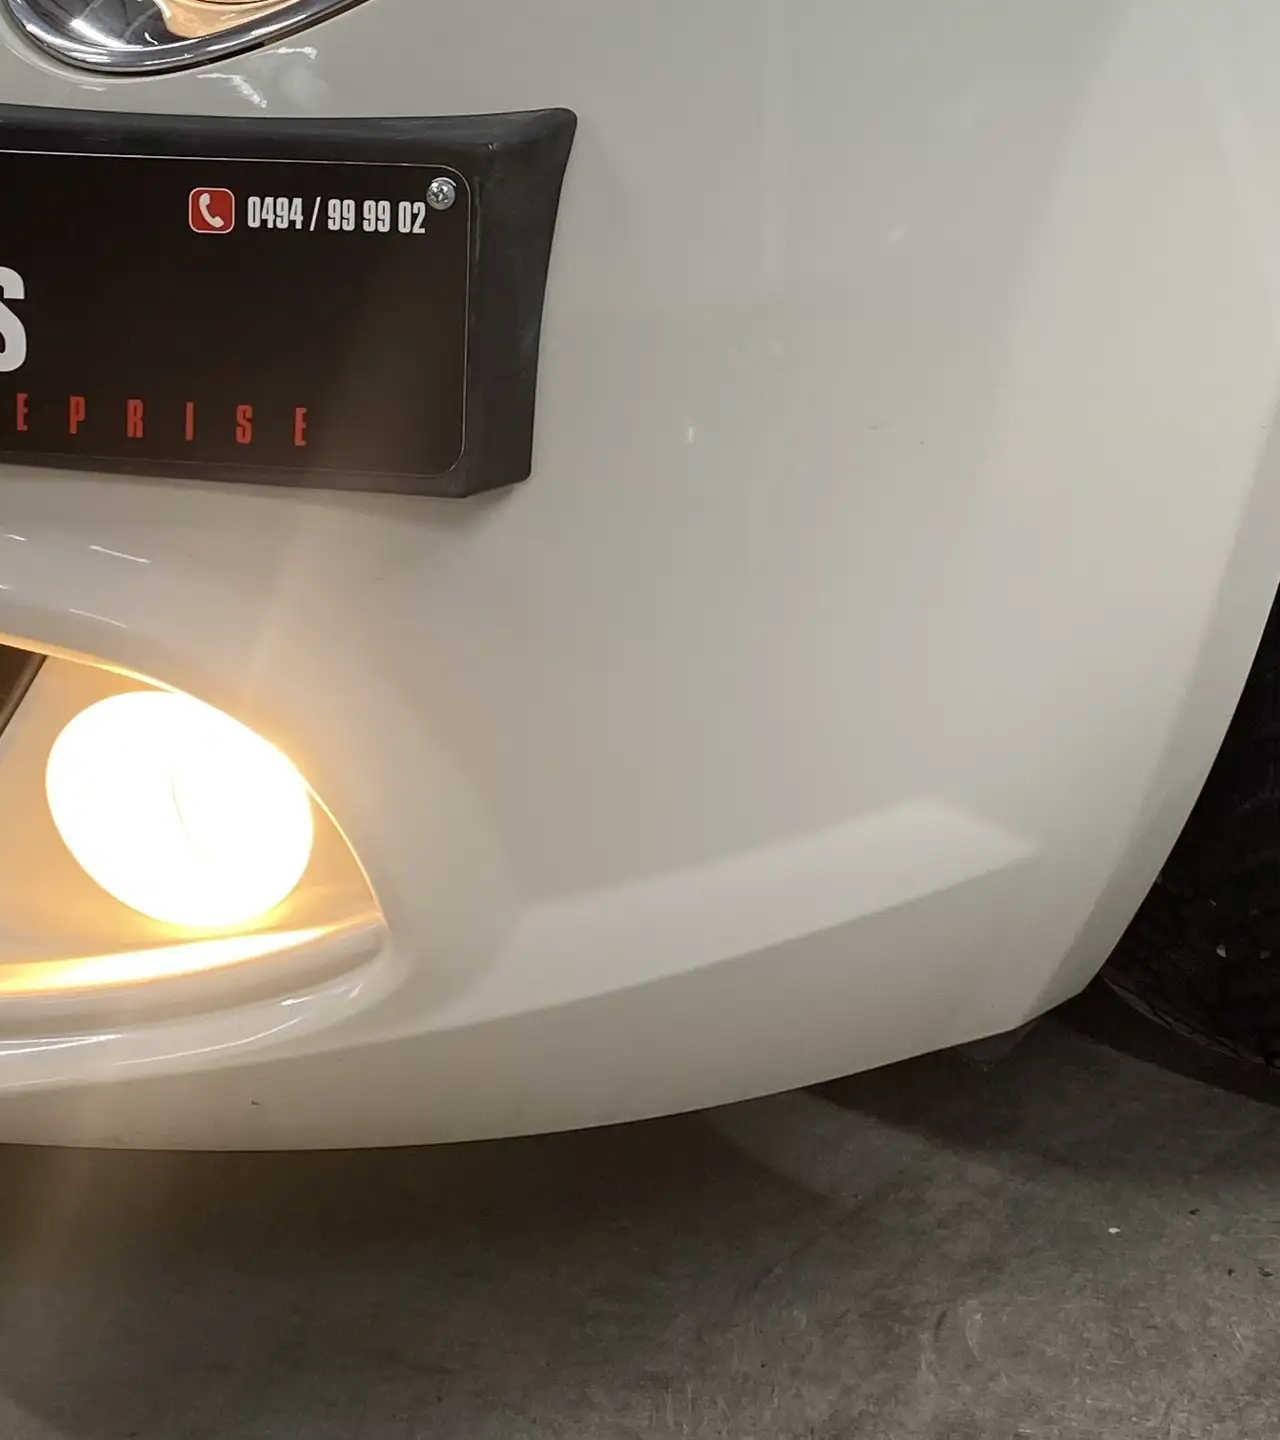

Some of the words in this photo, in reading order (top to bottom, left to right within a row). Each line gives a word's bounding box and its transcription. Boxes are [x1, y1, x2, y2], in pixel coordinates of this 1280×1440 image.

[247, 196, 304, 229] 0494
[309, 196, 321, 232] /
[327, 198, 355, 231] 99
[362, 200, 391, 233] 99
[398, 201, 426, 234] 02
